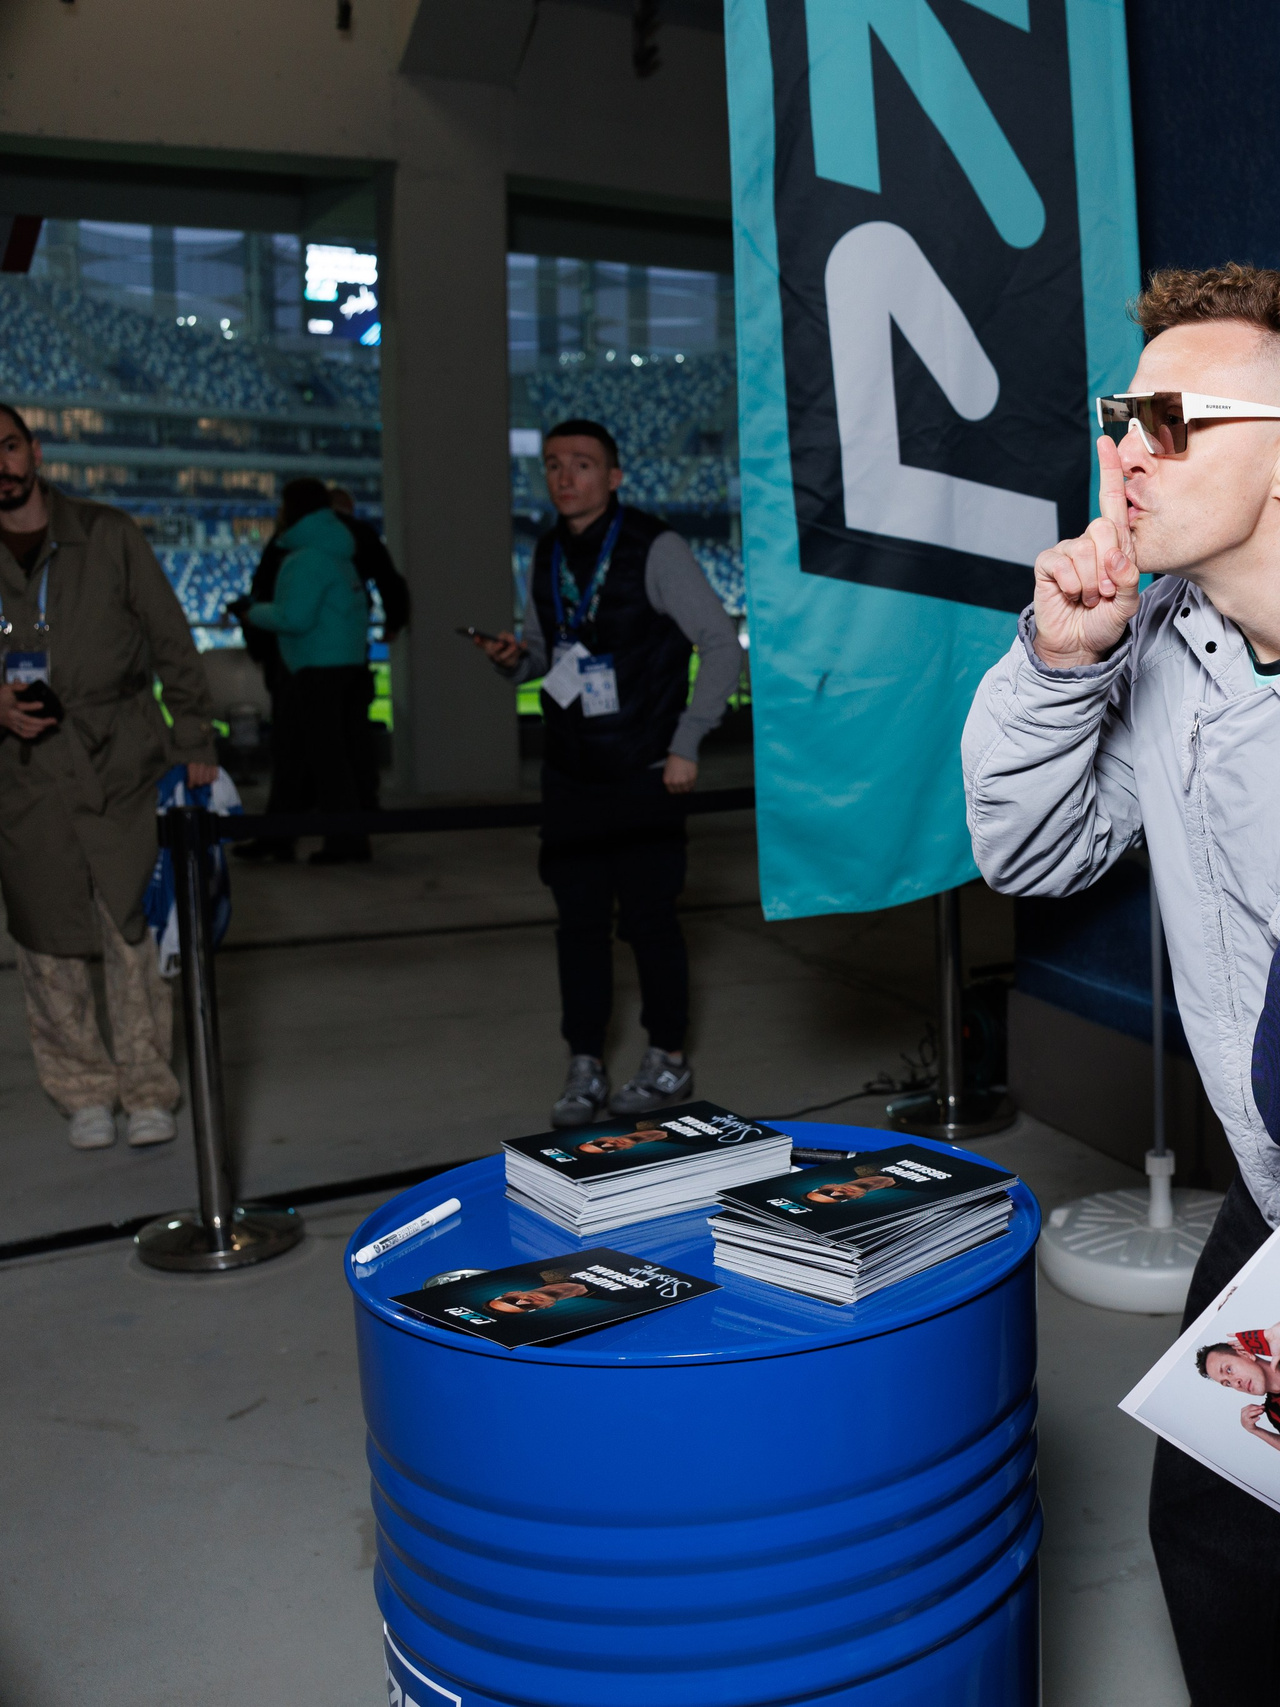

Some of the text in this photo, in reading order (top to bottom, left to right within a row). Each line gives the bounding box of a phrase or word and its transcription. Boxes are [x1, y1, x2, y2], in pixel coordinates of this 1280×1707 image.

[880, 1165, 932, 1183] АНДРЕЙ
[896, 1159, 953, 1180] SIBSKANA
[766, 1198, 808, 1214] PARI
[569, 1271, 628, 1291] АНДРЕЙ
[586, 1264, 650, 1289] SIBSKANA
[444, 1307, 491, 1325] PARI
